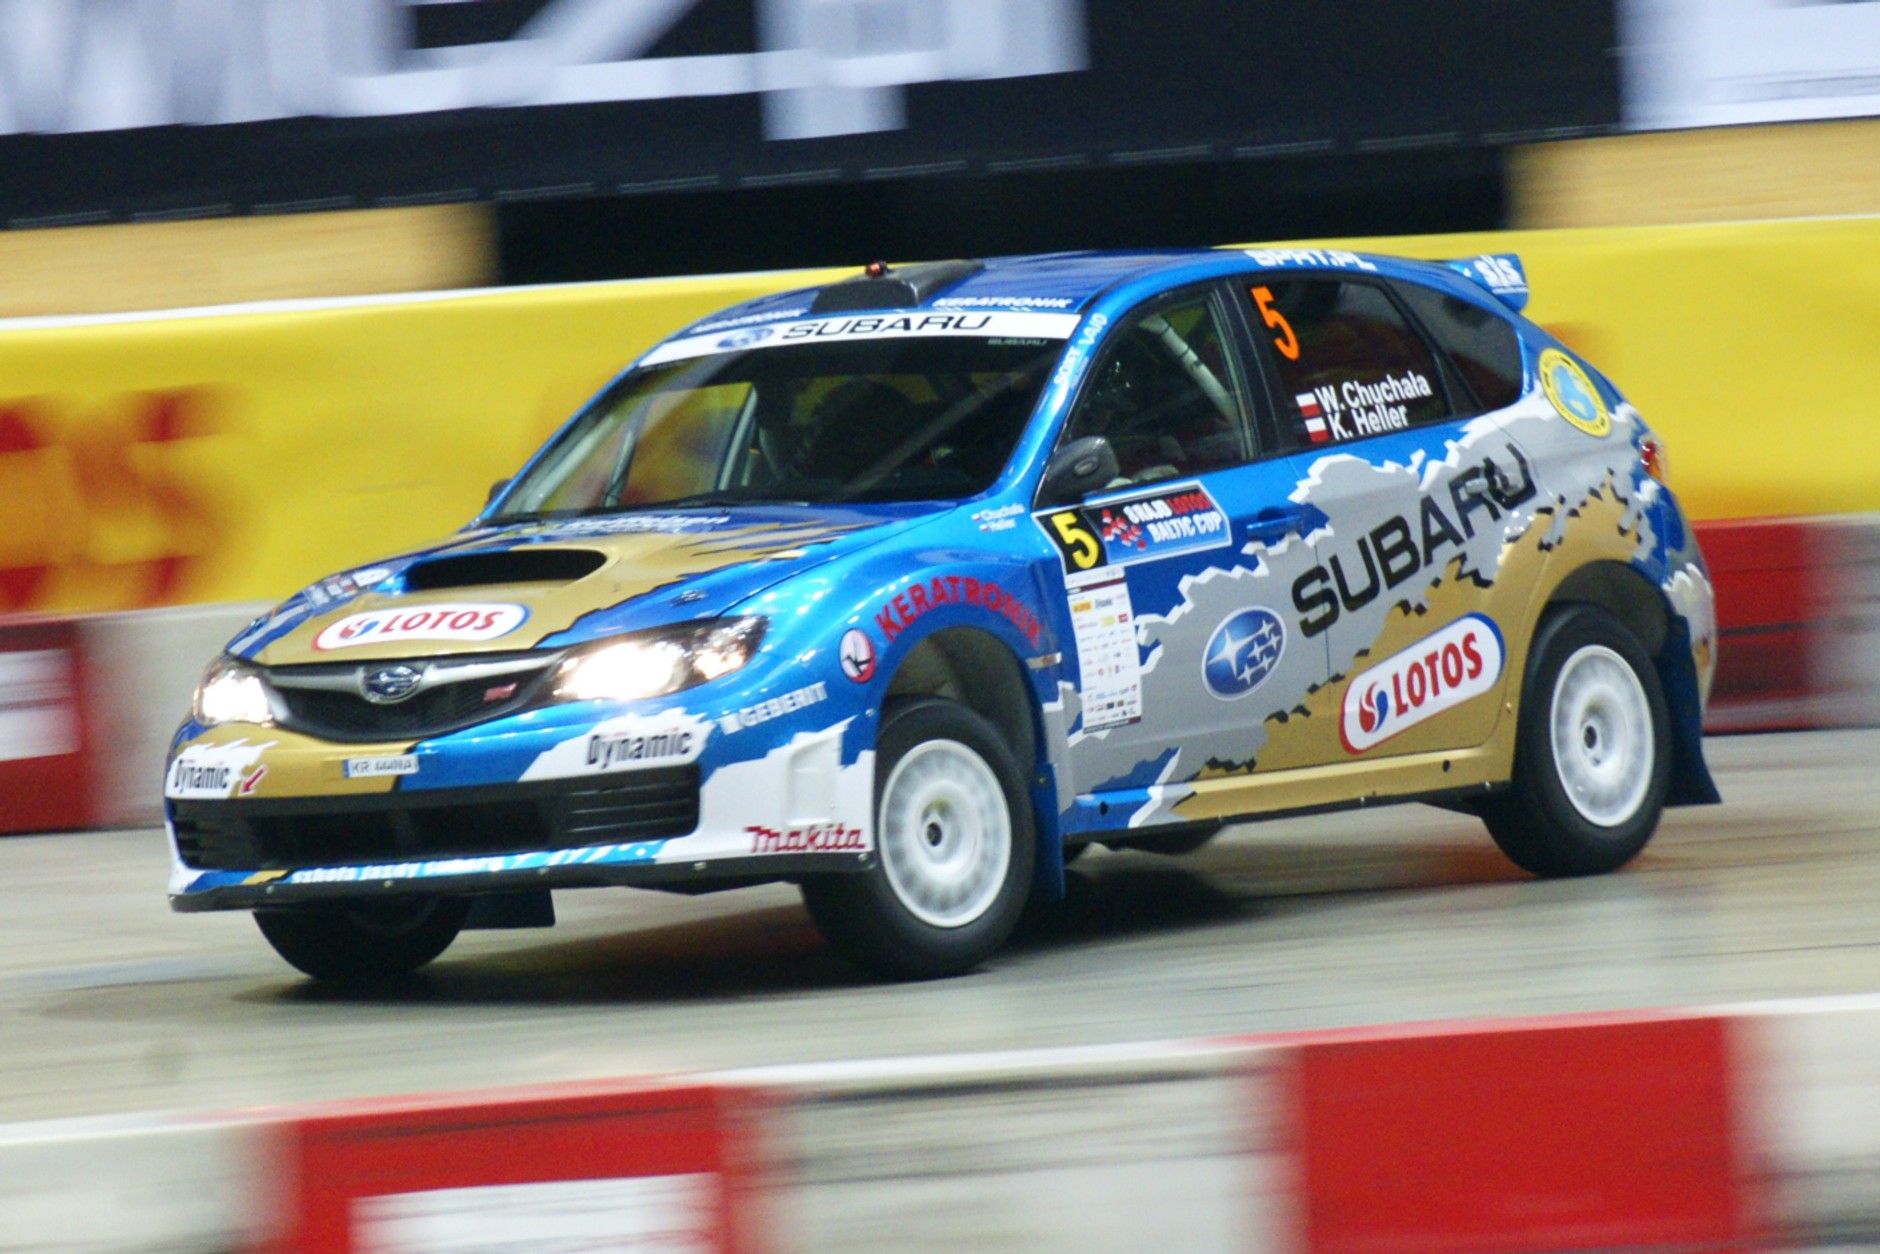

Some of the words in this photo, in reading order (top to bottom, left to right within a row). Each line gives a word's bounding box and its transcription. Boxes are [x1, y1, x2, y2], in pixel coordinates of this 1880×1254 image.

[781, 314, 992, 341] SUBARU
[1078, 312, 1108, 345] VAIO
[1251, 285, 1299, 361] 5
[1314, 384, 1346, 413] W.
[1327, 411, 1353, 441] K.
[1351, 404, 1409, 436] Heller
[1050, 511, 1100, 569] 5
[1146, 516, 1196, 543] BALTIC
[1192, 511, 1222, 534] CUP
[1291, 442, 1537, 638] SUBARU
[381, 610, 504, 634] LOTOS
[875, 575, 1044, 648] KERATRONIK
[1392, 631, 1484, 718] LOTOS
[585, 729, 693, 770] Dynamic
[173, 758, 230, 795] Dynamic
